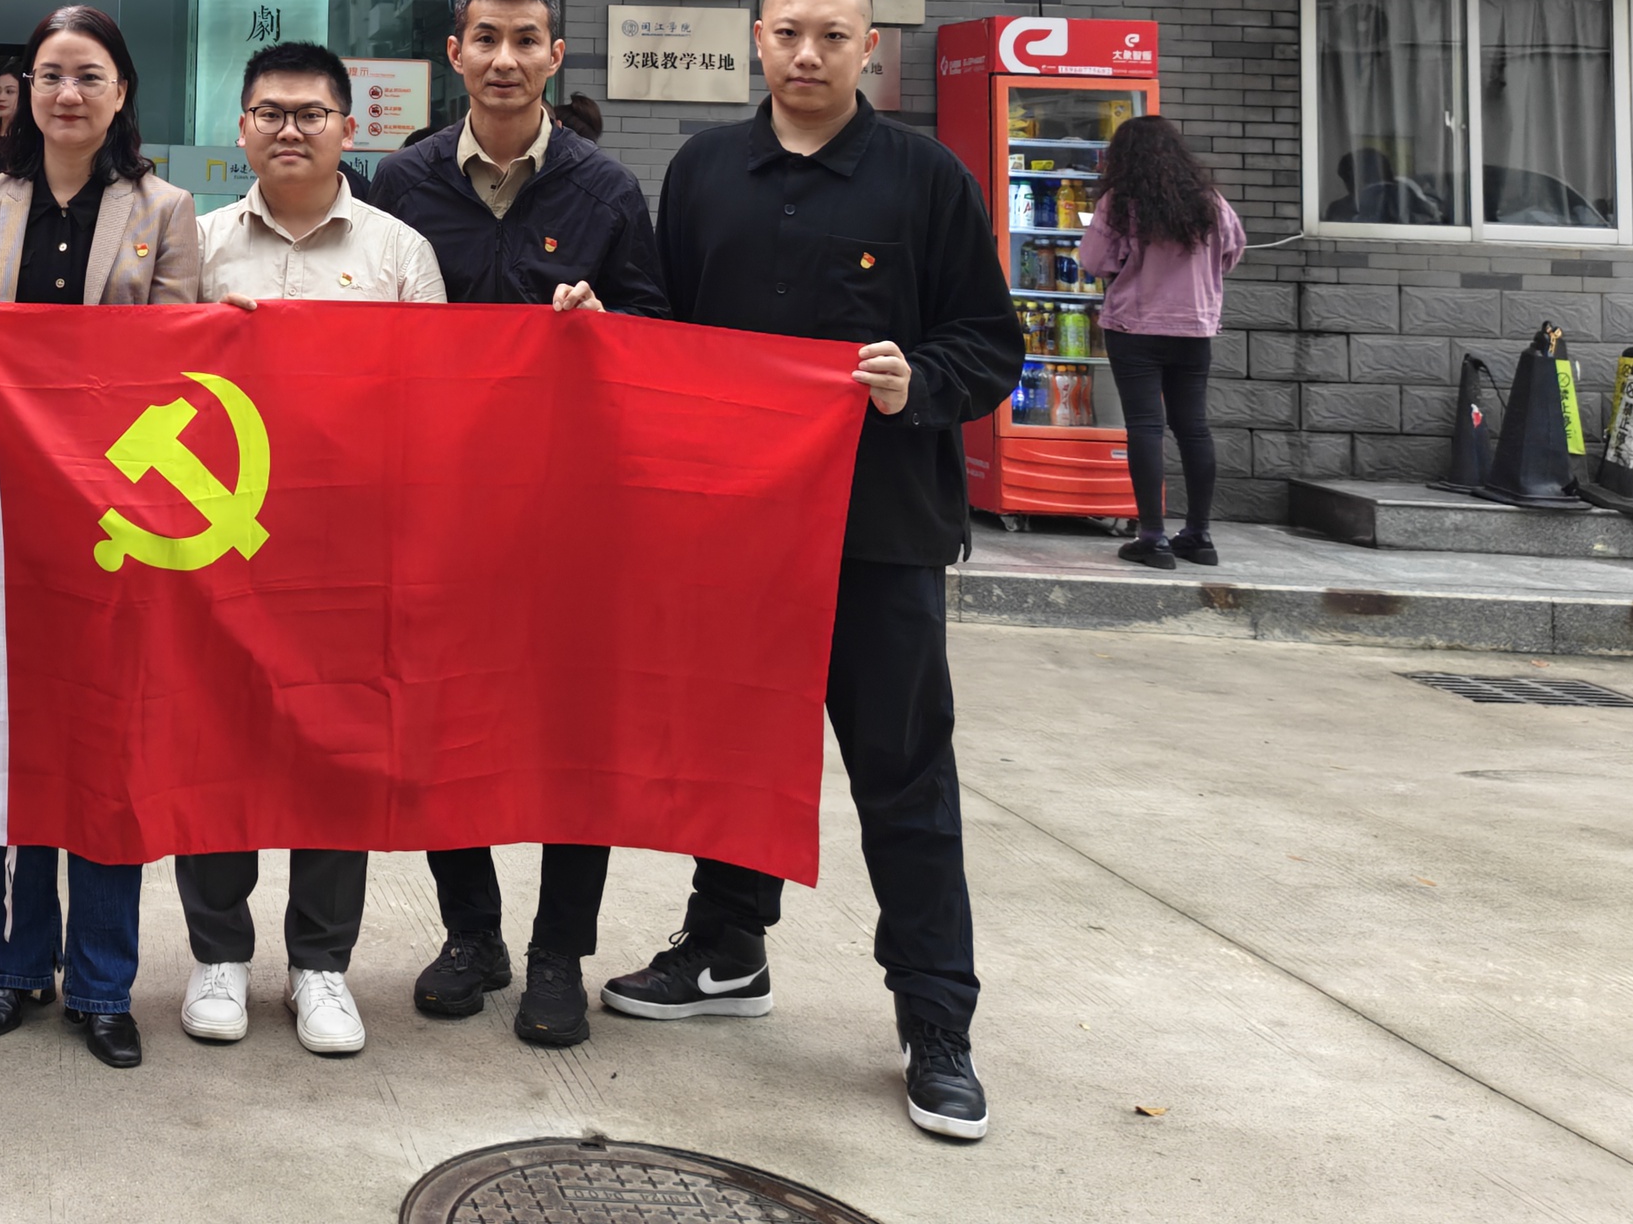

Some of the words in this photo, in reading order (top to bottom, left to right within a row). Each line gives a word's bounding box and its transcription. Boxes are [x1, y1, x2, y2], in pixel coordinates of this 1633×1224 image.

[641, 22, 691, 33] 闽江学院
[623, 50, 735, 71] 实践教学基地
